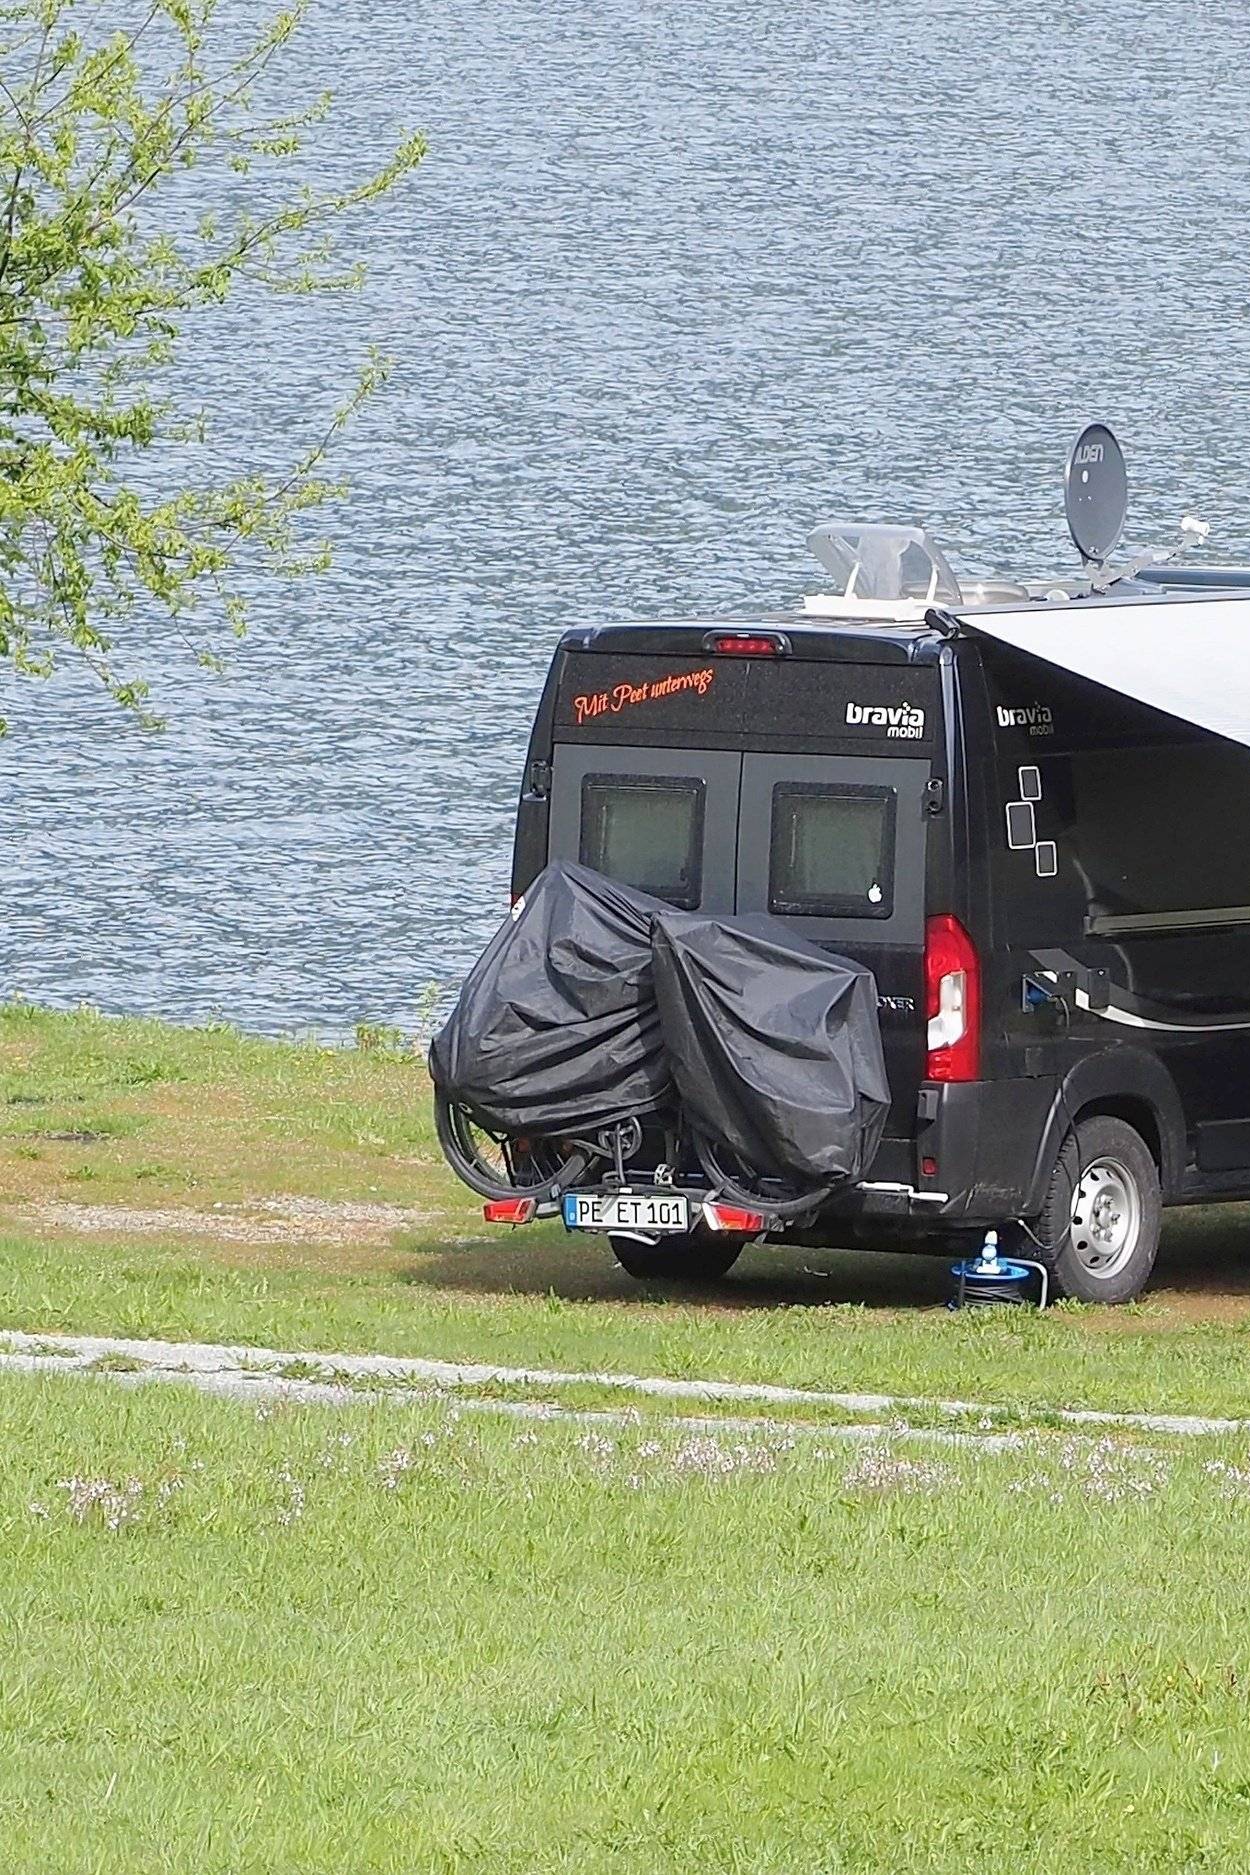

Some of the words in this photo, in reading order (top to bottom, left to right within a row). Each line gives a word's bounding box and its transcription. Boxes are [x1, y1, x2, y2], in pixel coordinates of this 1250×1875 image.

[574, 693, 608, 724] Mit
[611, 683, 648, 712] Peet
[650, 667, 714, 697] unterwegs
[846, 701, 925, 726] bravia
[996, 701, 1053, 727] bravia
[887, 725, 924, 739] mobil
[579, 1200, 604, 1223] PE
[617, 1202, 642, 1224] ET
[647, 1203, 683, 1225] 101
